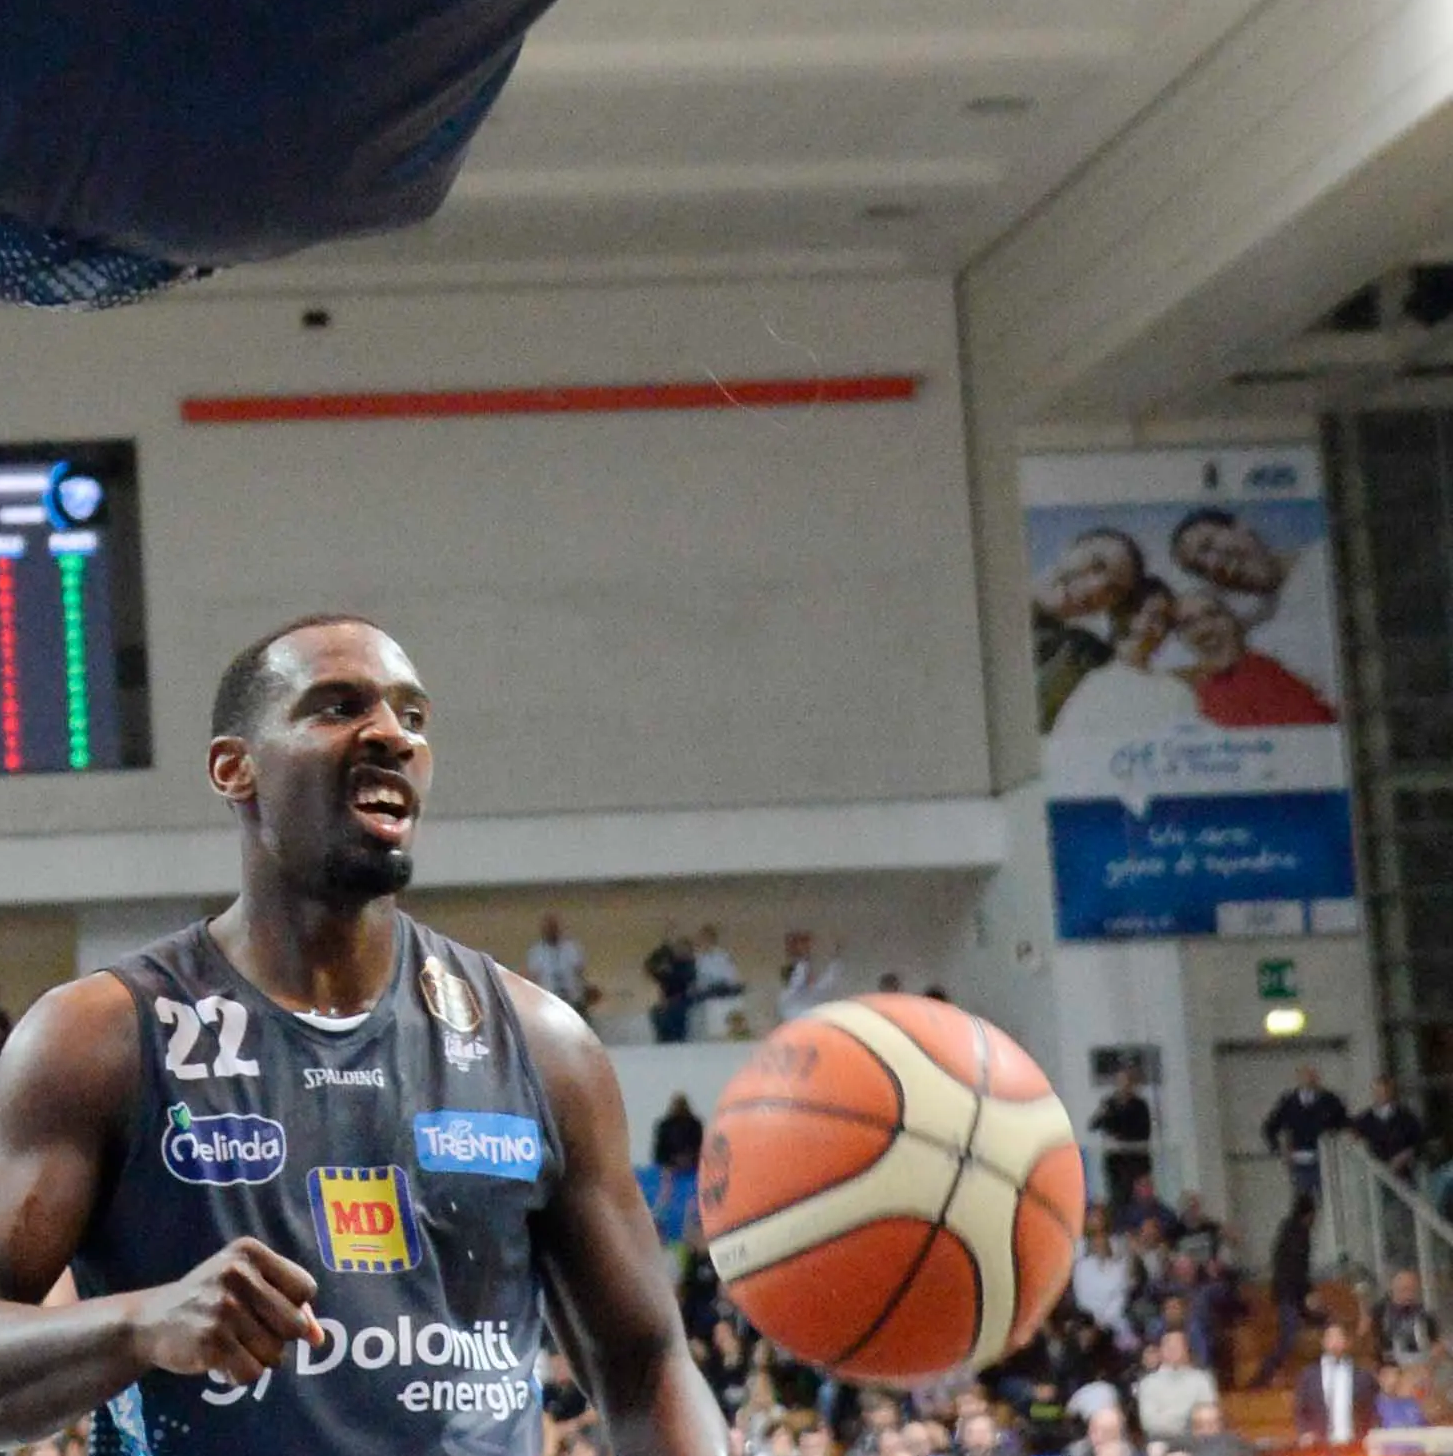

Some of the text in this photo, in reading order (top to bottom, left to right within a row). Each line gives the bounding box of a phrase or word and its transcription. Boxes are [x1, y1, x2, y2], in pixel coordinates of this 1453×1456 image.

[154, 994, 260, 1081] 22
[303, 1066, 385, 1090] SPALDING
[169, 1122, 281, 1164] Melinda
[420, 1125, 538, 1165] TRENTINO
[330, 1200, 396, 1238] MD
[295, 1314, 521, 1376] Dolomiti
[397, 1374, 530, 1421] energia
